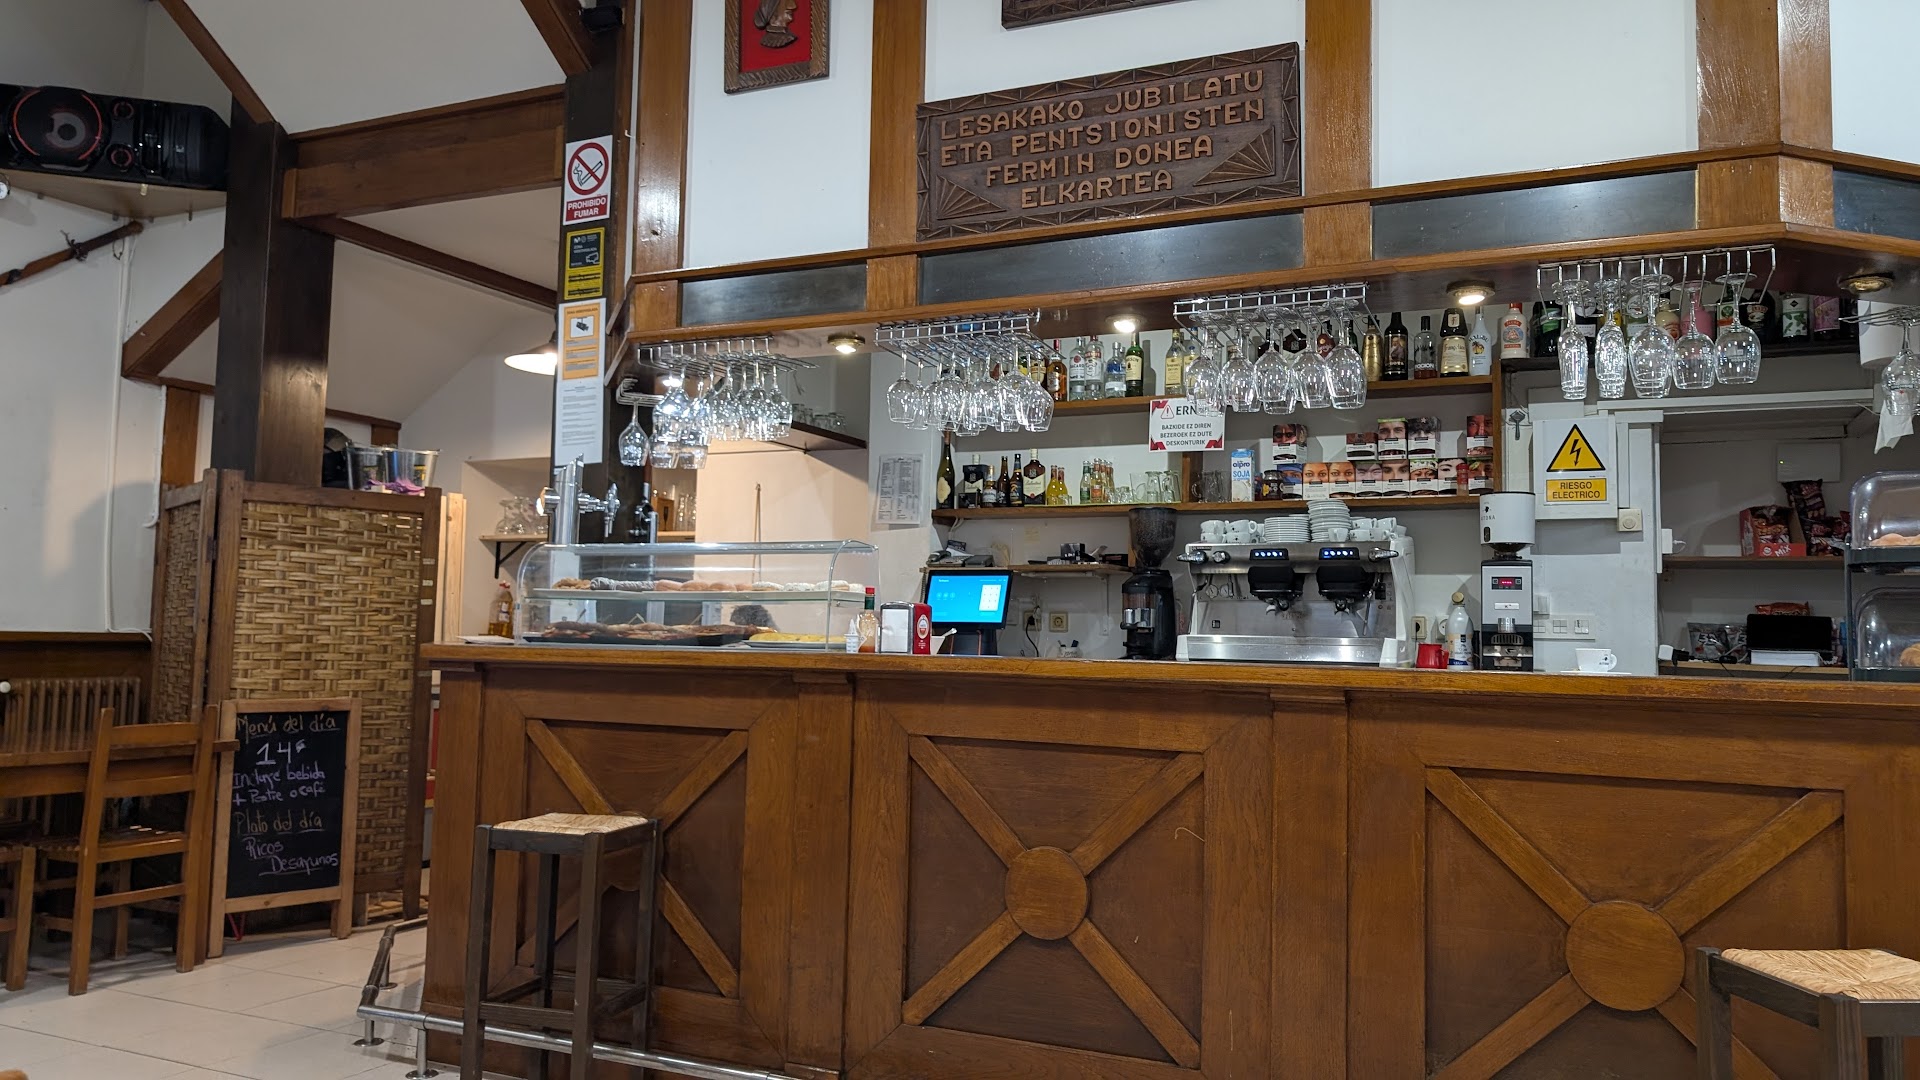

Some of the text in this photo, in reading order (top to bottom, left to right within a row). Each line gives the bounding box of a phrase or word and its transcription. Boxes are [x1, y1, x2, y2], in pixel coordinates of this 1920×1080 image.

[941, 70, 1264, 140] LESAKAKO JUBILATU
[941, 98, 1265, 167] ETA PENTSIONISTEN
[986, 134, 1213, 187] FERMIN DONEA
[1021, 169, 1173, 209] ELKARTEA
[567, 197, 606, 211] PROHIBIDO
[573, 207, 599, 219] FUMAR
[1176, 405, 1200, 415] ERN
[1232, 461, 1250, 469] alpro
[1232, 470, 1250, 478] SOJA
[1552, 490, 1601, 499] ELECTRICO
[1560, 481, 1593, 490] RIESGO
[237, 713, 338, 744] Menú del día
[287, 761, 326, 780] bebida
[235, 809, 323, 836] Plato del día
[242, 837, 284, 858] Ricos
[271, 853, 339, 875] Desayunos
